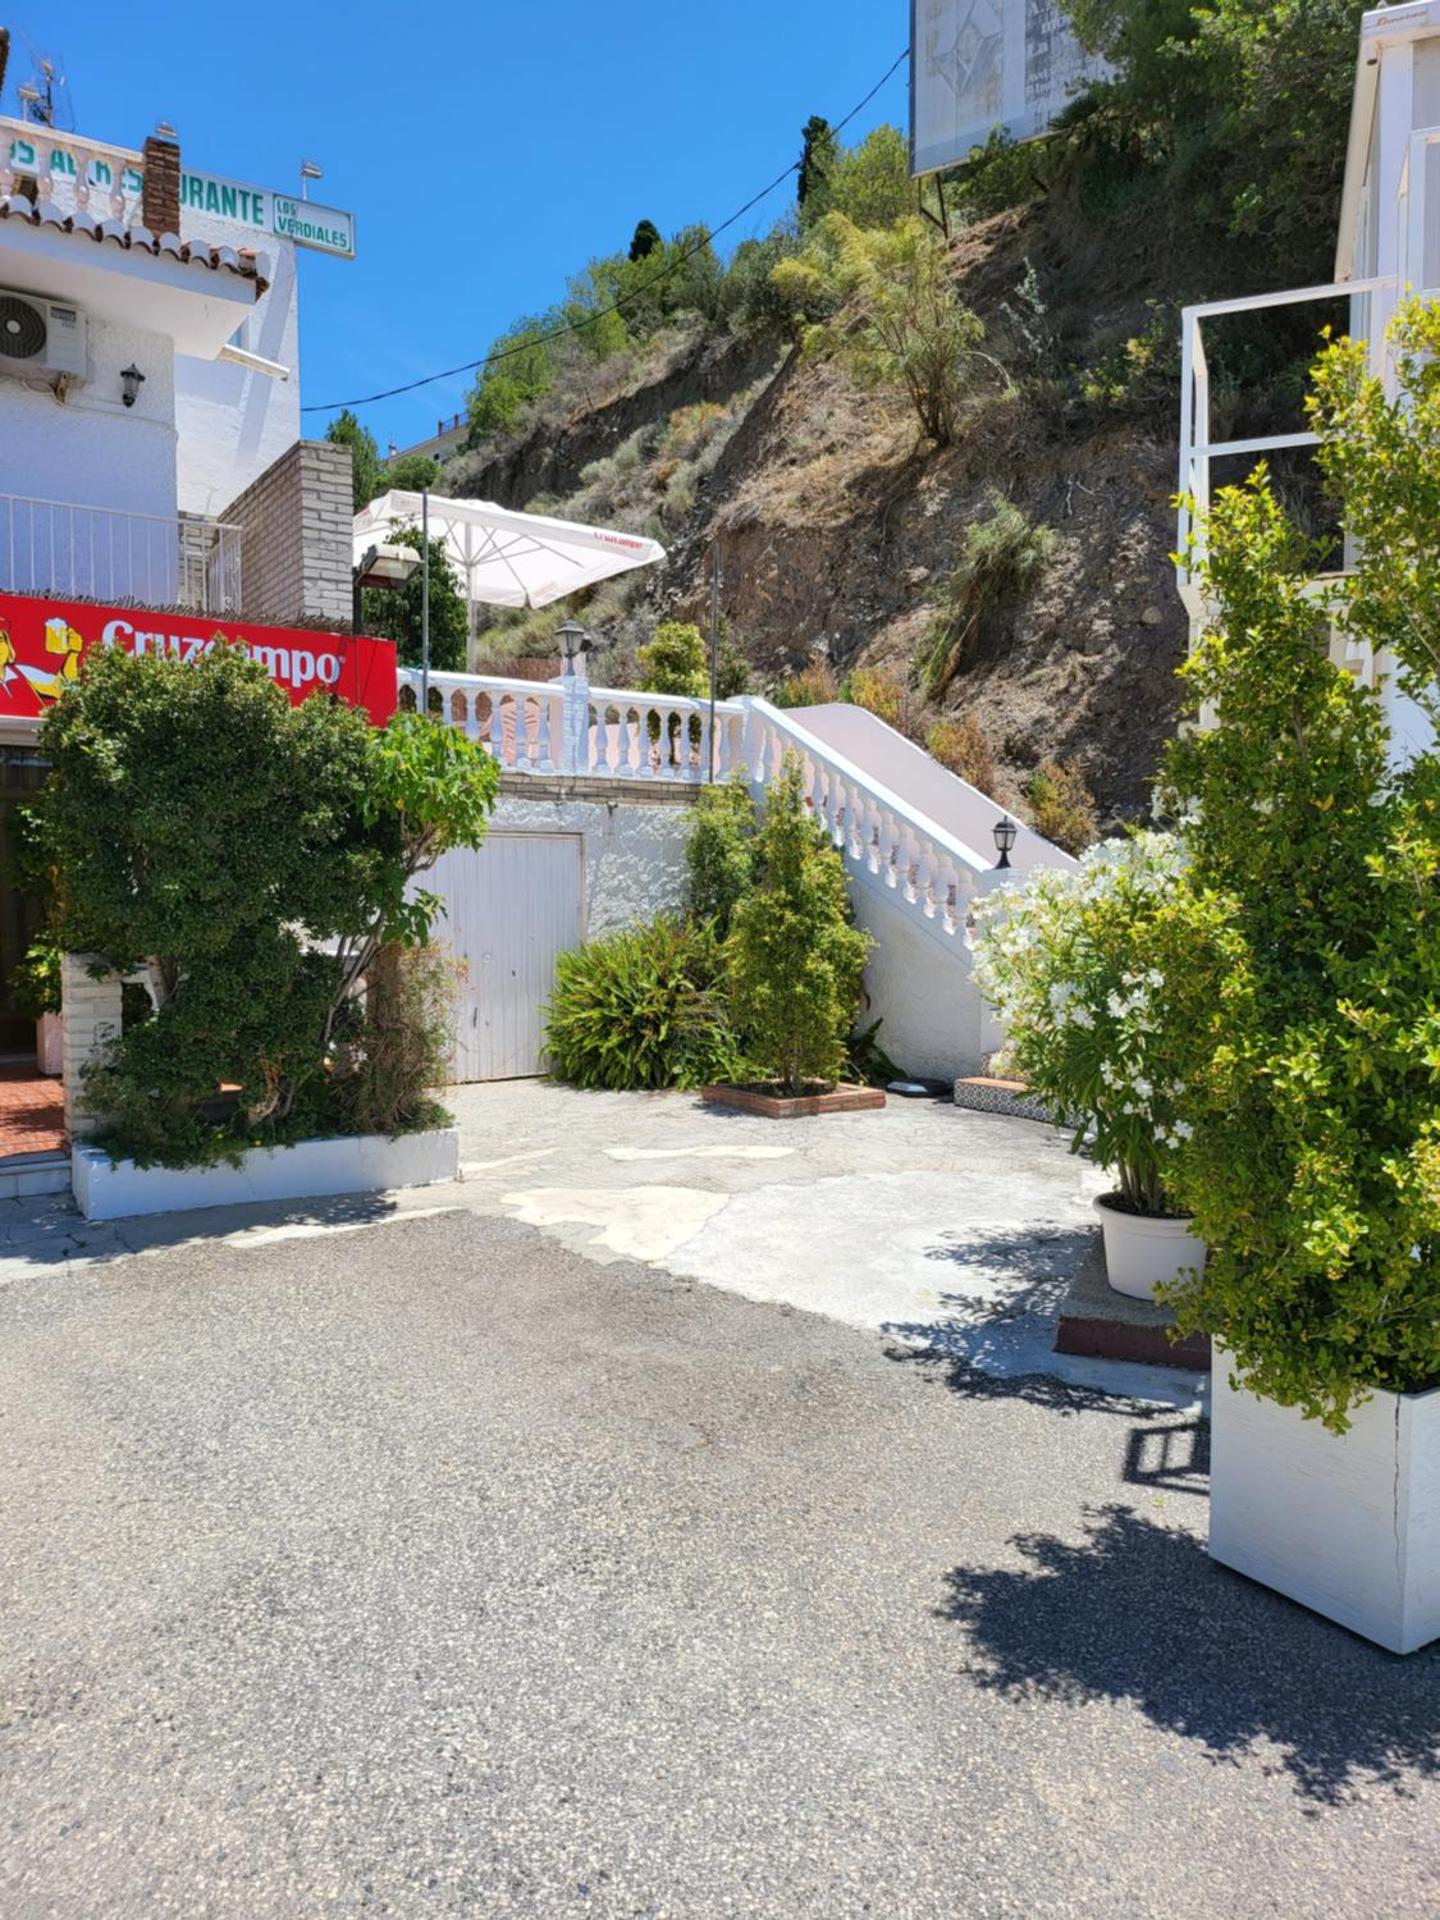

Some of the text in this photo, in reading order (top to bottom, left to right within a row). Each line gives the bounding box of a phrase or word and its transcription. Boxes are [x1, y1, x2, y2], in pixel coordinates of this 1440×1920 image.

[277, 200, 296, 216] LOS
[277, 216, 348, 248] VERDIALES
[102, 620, 341, 688] Cruzmpo
